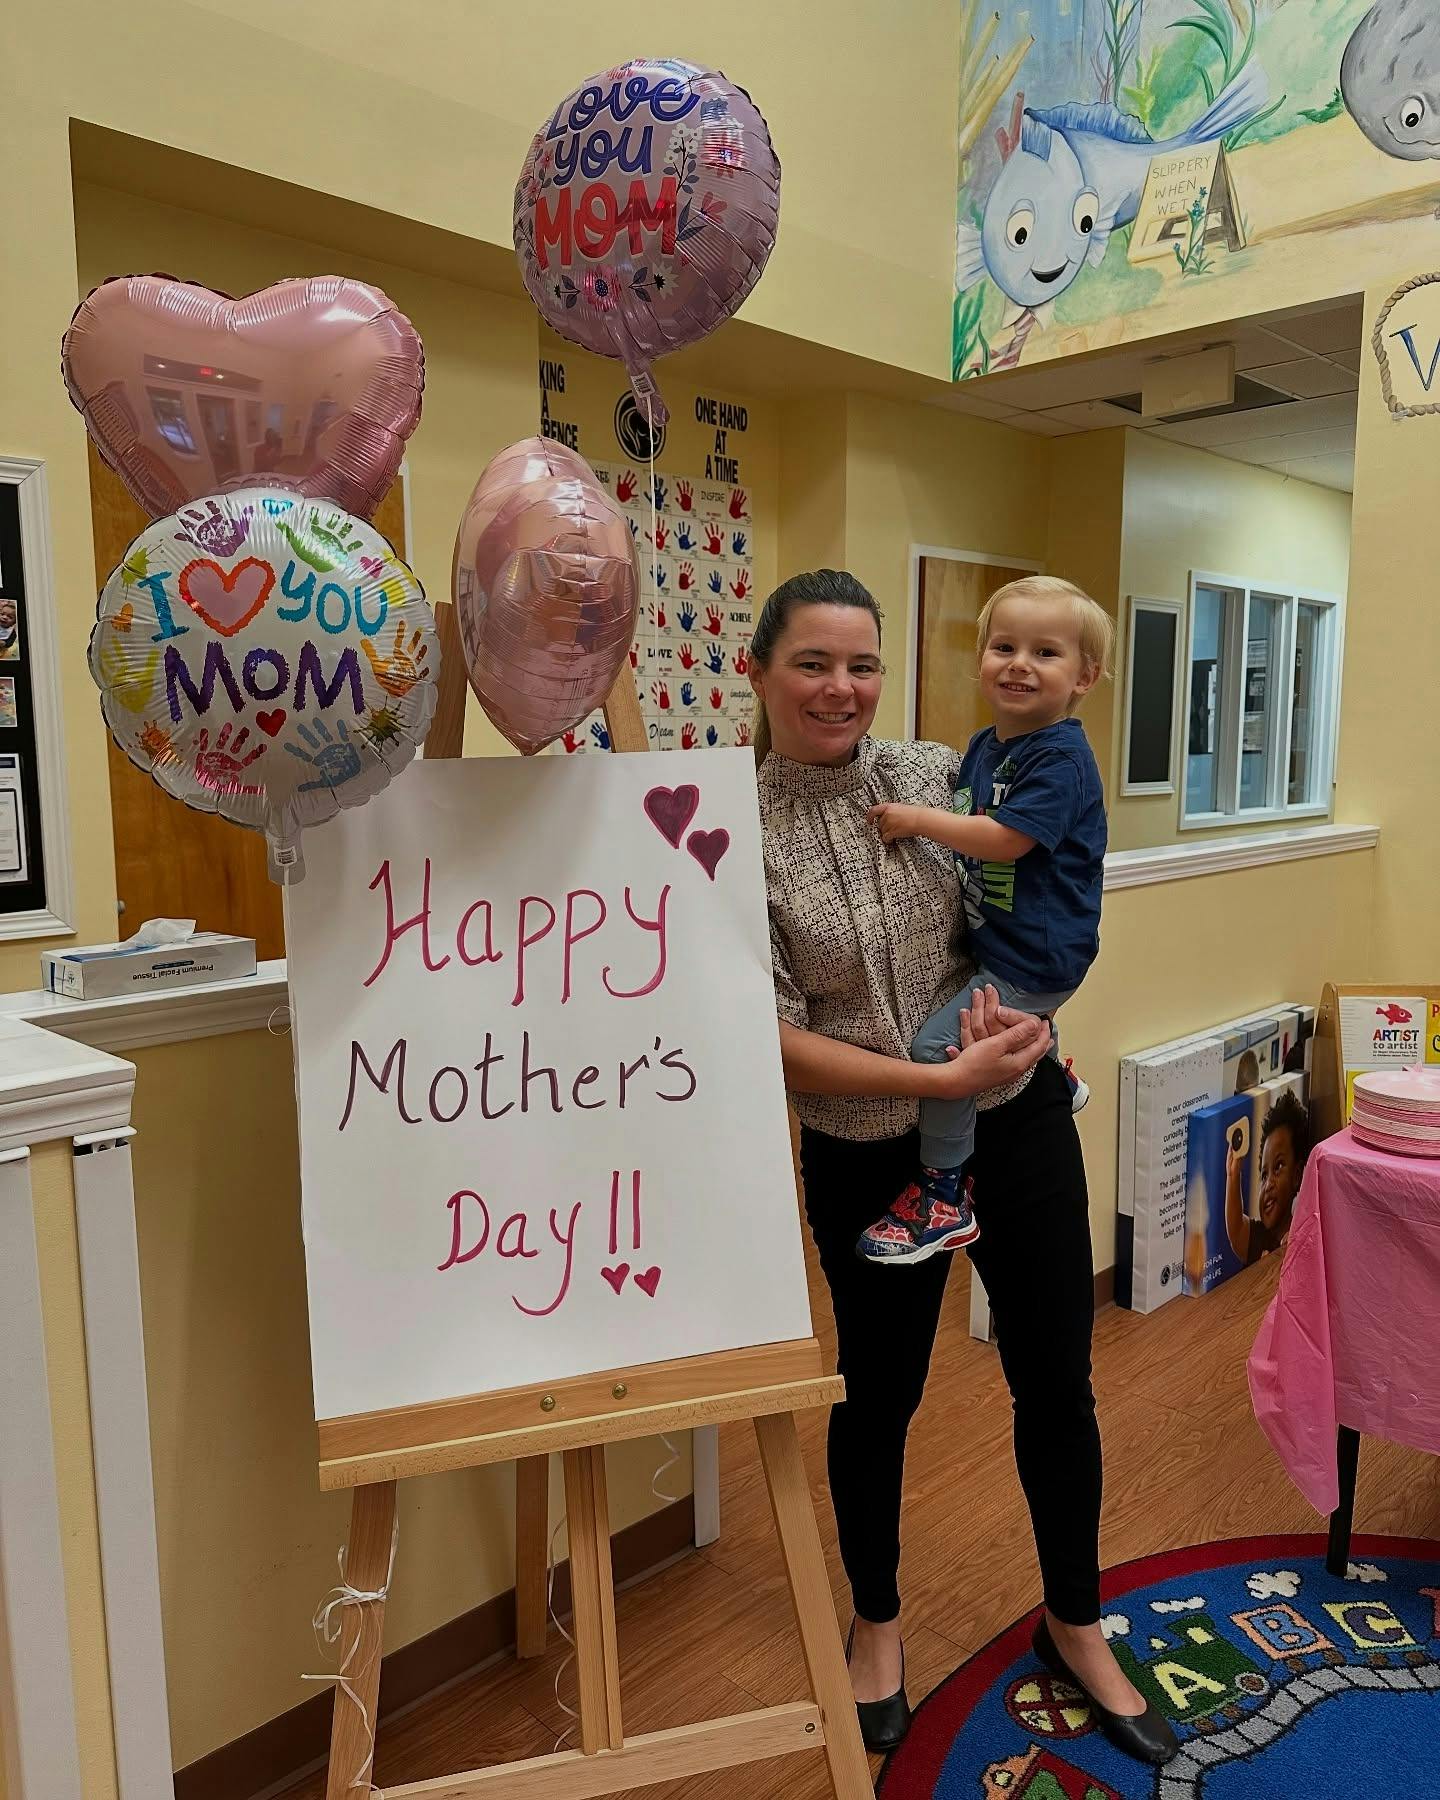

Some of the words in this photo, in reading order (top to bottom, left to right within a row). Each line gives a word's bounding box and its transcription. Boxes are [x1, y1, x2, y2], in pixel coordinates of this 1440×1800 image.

[1152, 155, 1212, 179] SLIPPERY
[1154, 176, 1197, 199] WHEN
[1157, 198, 1188, 216] WET
[534, 176, 677, 272] MOM
[541, 388, 550, 419] A
[695, 396, 717, 426] ONE
[719, 402, 748, 432] HAND
[541, 418, 579, 453] RENCE
[714, 429, 727, 455] AT
[705, 454, 713, 480] A
[714, 455, 738, 485] TIME
[137, 570, 190, 642] I
[363, 857, 672, 1007] Happy
[132, 972, 157, 980] Tissue
[158, 969, 181, 979] Facial
[182, 964, 214, 974] Premium
[1372, 1029, 1420, 1042] ARTIST
[1373, 1042, 1385, 1050] to
[1387, 1042, 1418, 1050] artist
[338, 1030, 698, 1132] Mother's
[1173, 1103, 1182, 1113] our
[1163, 1127, 1184, 1143] curiosity
[1162, 1141, 1182, 1156] children
[1164, 1154, 1182, 1168] wonder
[1160, 1181, 1169, 1189] The
[1169, 1174, 1181, 1186] skills
[1164, 1189, 1175, 1201] here
[1176, 1184, 1184, 1195] will
[1160, 1200, 1179, 1217] become
[1160, 1217, 1171, 1228] who
[1172, 1212, 1180, 1222] are
[1163, 1227, 1175, 1240] take
[1152, 1659, 1227, 1711] A
[1249, 1607, 1318, 1653] B
[1342, 1606, 1405, 1643] C
